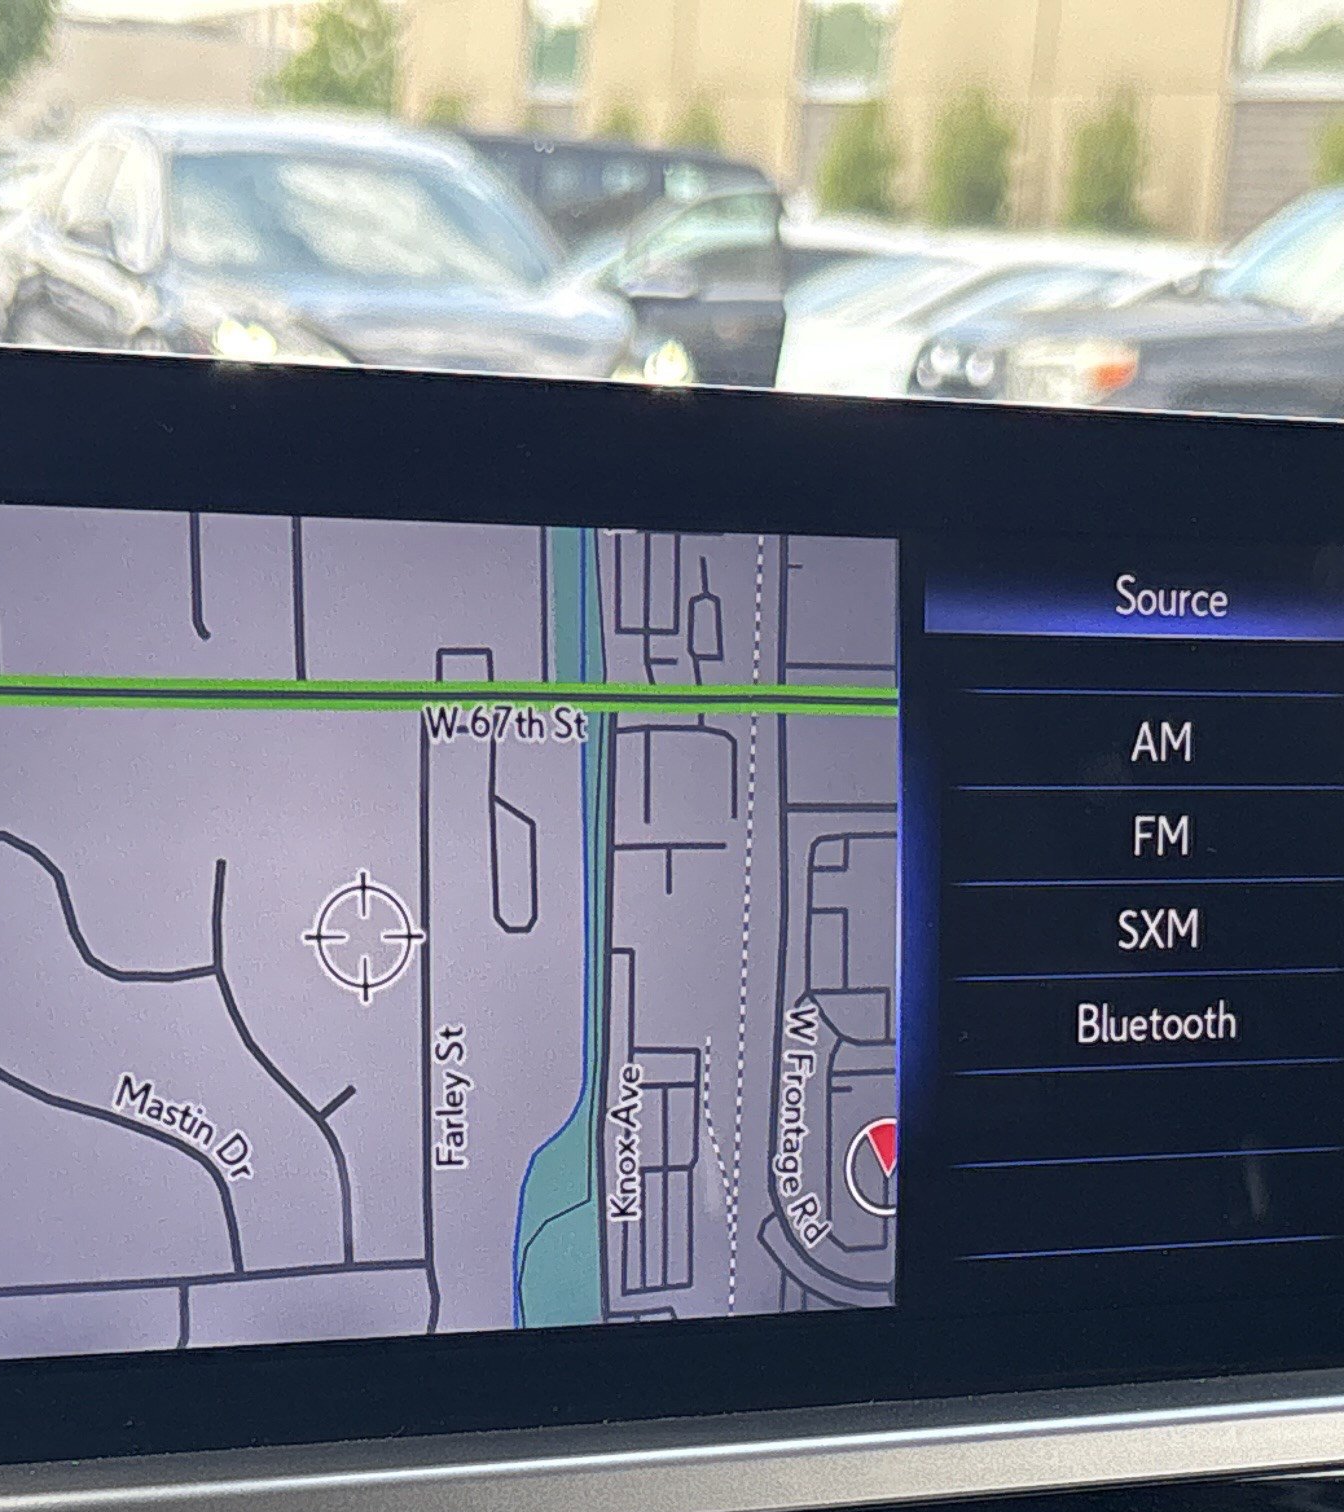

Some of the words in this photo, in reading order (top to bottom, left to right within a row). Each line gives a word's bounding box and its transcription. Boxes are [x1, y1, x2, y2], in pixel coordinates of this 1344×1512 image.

[1115, 575, 1229, 618] Source
[424, 706, 460, 738] W
[470, 706, 544, 740] 67th
[554, 706, 587, 739] St
[1131, 722, 1192, 761] AM
[1133, 816, 1190, 855] FM
[1118, 909, 1198, 949] SXM
[788, 1007, 816, 1040] W
[1077, 1000, 1238, 1043] Bluetooth
[436, 1026, 465, 1064] St
[611, 1066, 640, 1128] Ave
[116, 1076, 215, 1147] Mastin
[215, 1133, 253, 1180] Dr
[437, 1072, 471, 1166] Farley
[774, 1052, 813, 1195] Frontage
[611, 1138, 640, 1217] Knox
[792, 1197, 829, 1243] Rd
